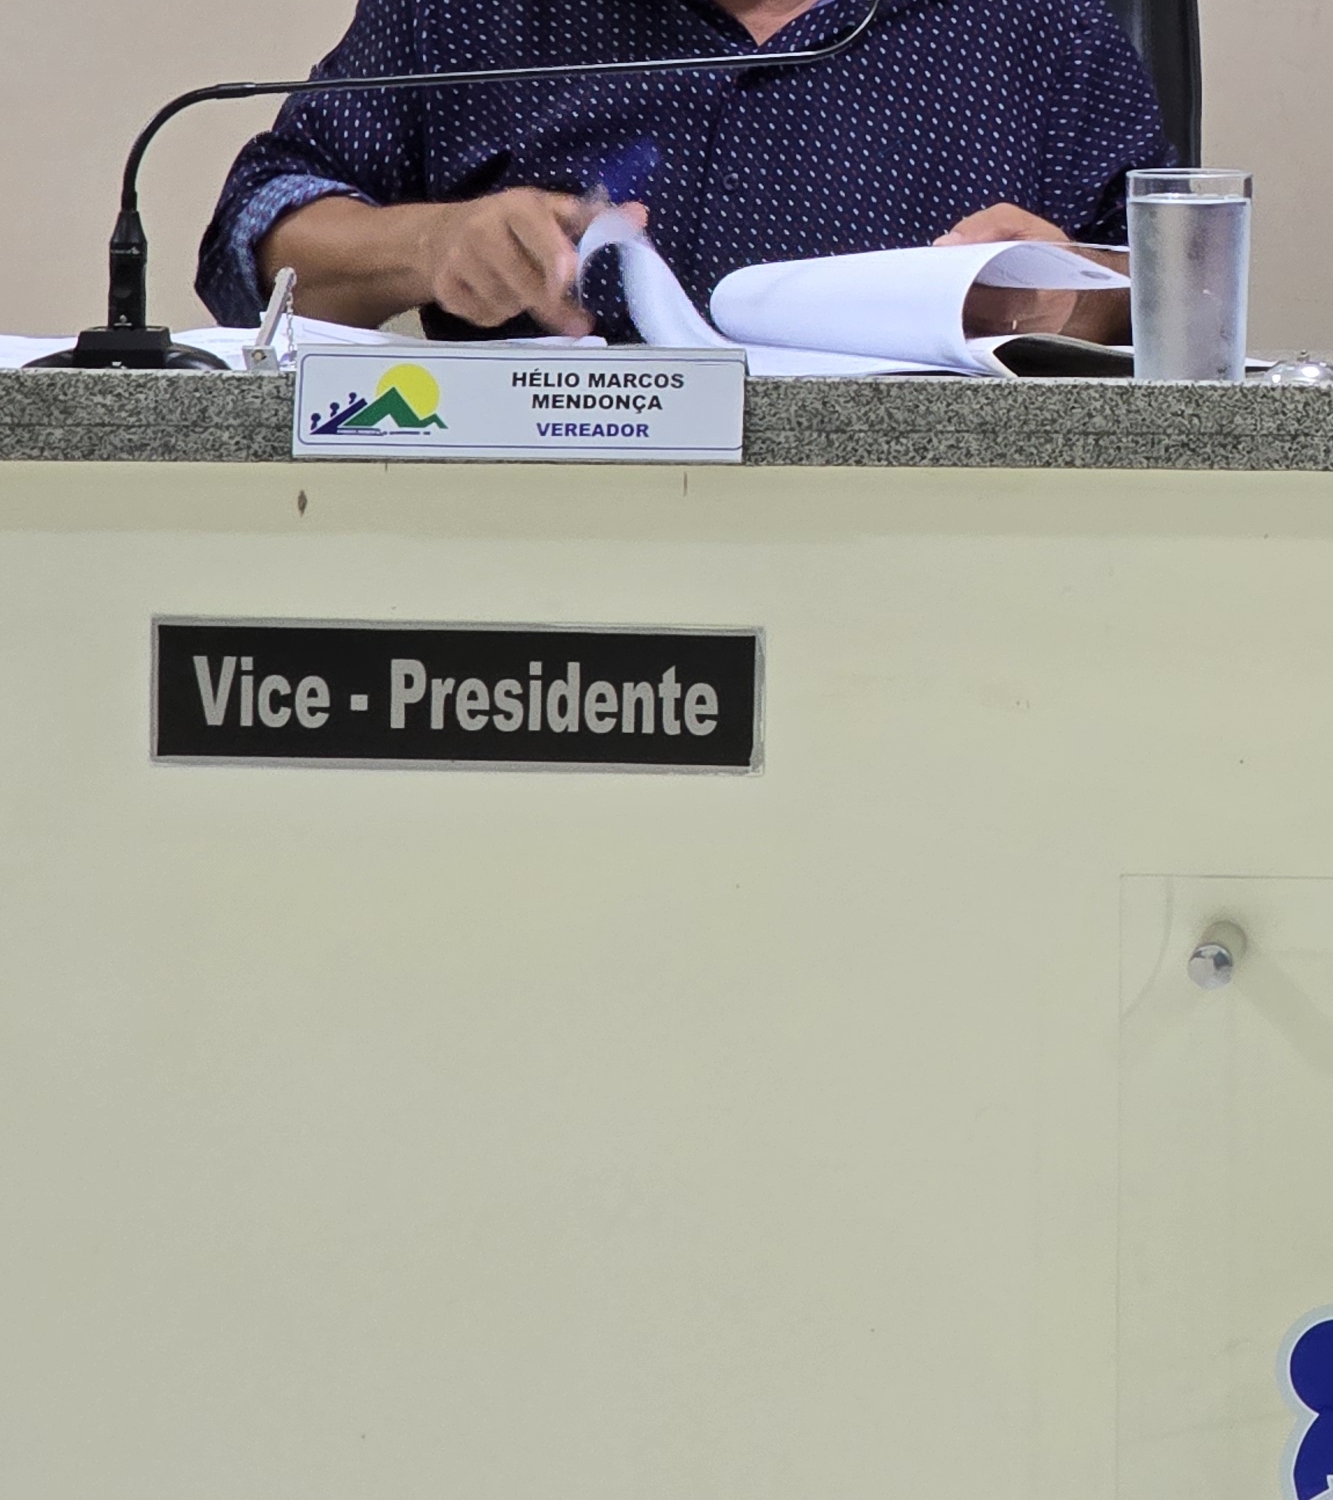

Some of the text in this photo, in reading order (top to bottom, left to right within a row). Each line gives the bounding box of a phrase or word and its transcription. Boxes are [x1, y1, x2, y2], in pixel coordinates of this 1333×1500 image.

[511, 368, 685, 389] HÉLIO MARCOS
[531, 393, 663, 414] MENDONÇA
[536, 422, 650, 438] VEREADOR
[193, 655, 330, 729] Vice
[390, 658, 719, 736] Presidente
